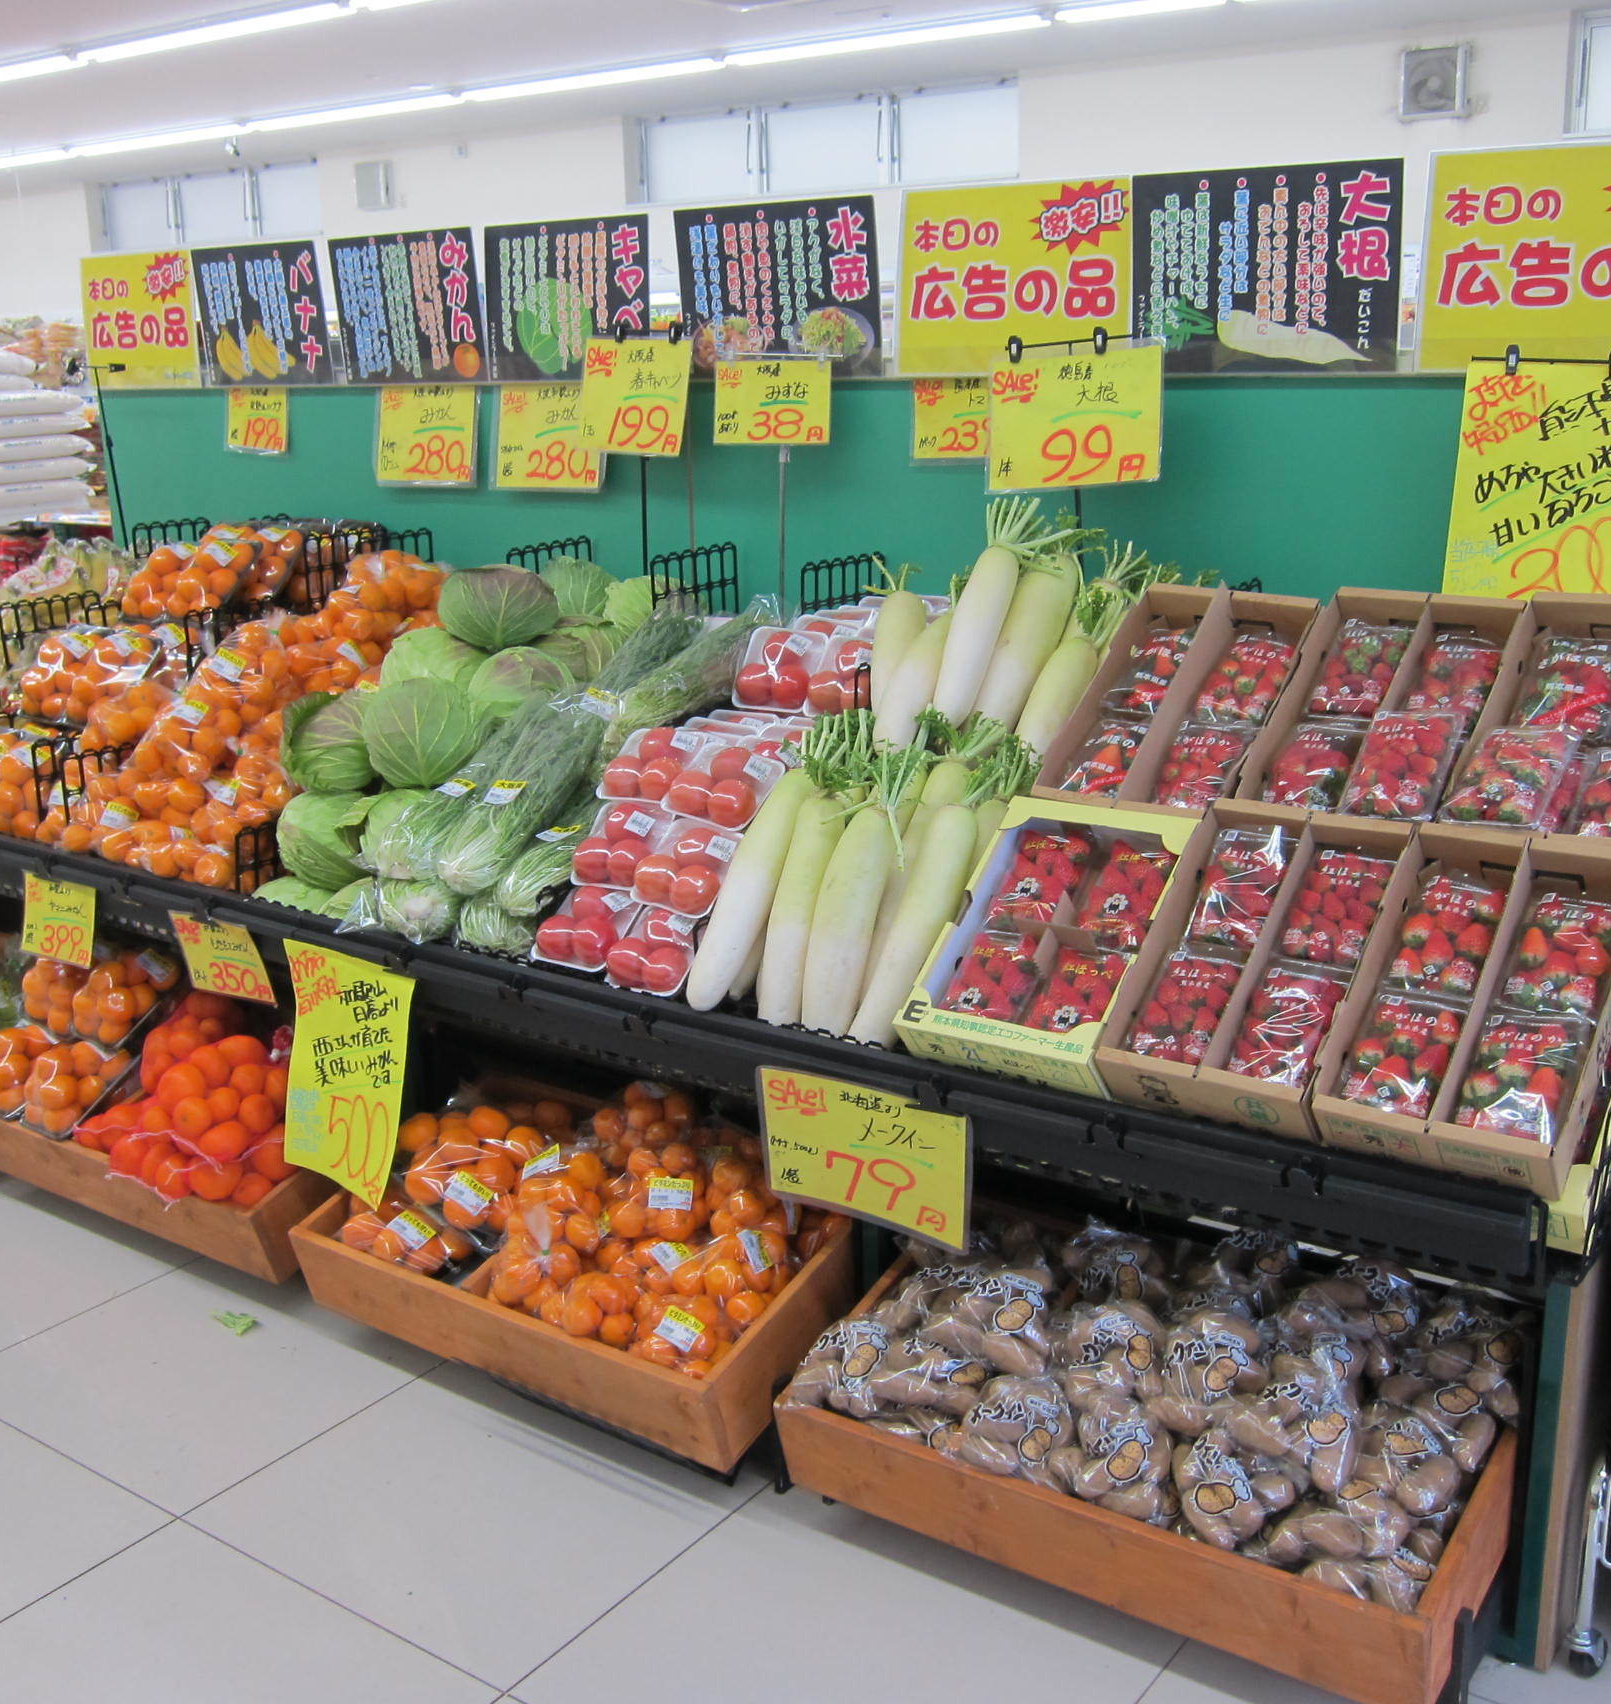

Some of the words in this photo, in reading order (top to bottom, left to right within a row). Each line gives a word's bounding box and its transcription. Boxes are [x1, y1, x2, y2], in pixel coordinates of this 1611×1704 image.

[1340, 171, 1391, 281] 大根
[1444, 185, 1562, 227] 本日の
[826, 206, 871, 302] 水菜
[914, 219, 998, 252] 本日の
[88, 277, 129, 301] 本日の
[439, 231, 477, 343] みかん
[911, 259, 1116, 320] 広告の品
[1219, 222, 1234, 321] サラダなど生に
[92, 306, 190, 350] 広告の品
[289, 249, 323, 374] バナナ
[1357, 288, 1373, 349] だいこん
[765, 381, 809, 401] みずな
[1075, 381, 1120, 407] 大根
[902, 999, 928, 1024] E
[858, 1116, 937, 1150] メークイン
